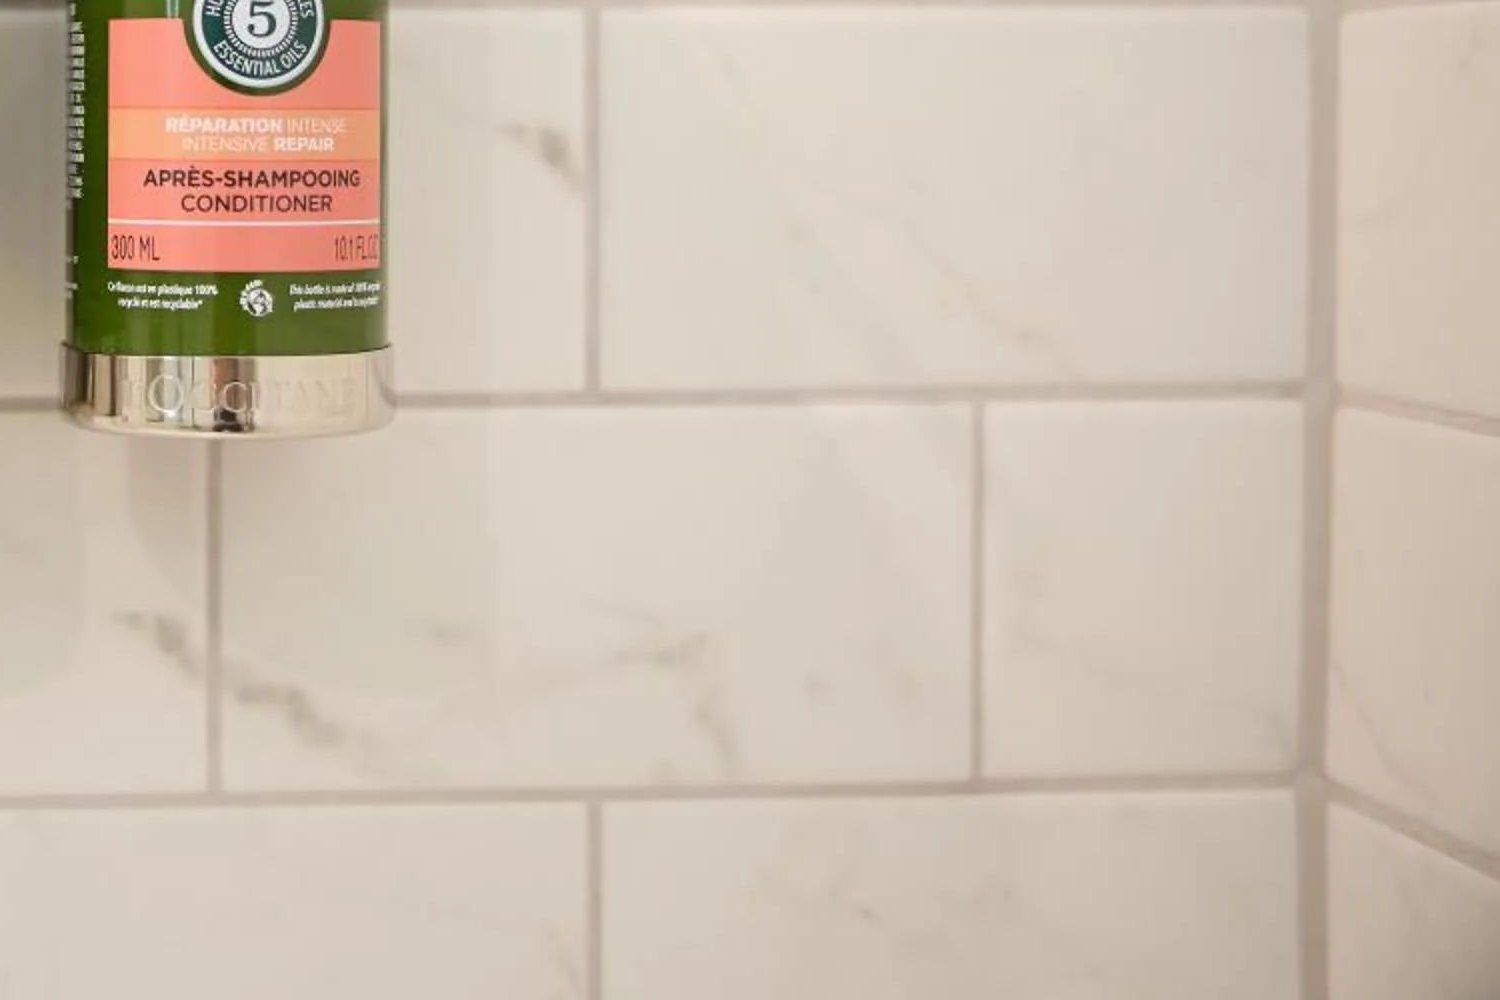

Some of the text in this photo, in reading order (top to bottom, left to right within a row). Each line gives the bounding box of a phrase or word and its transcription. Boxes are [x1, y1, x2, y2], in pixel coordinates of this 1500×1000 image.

[247, 0, 278, 37] 5
[212, 39, 308, 77] ESSENTIAL OILS
[165, 115, 348, 133] RÉPARATION INTENSE
[273, 136, 335, 151] REPAIR
[143, 166, 361, 188] APRÈS-SHAMPOOING
[181, 194, 333, 213] CONDITIONER
[111, 236, 161, 261] 300 ML
